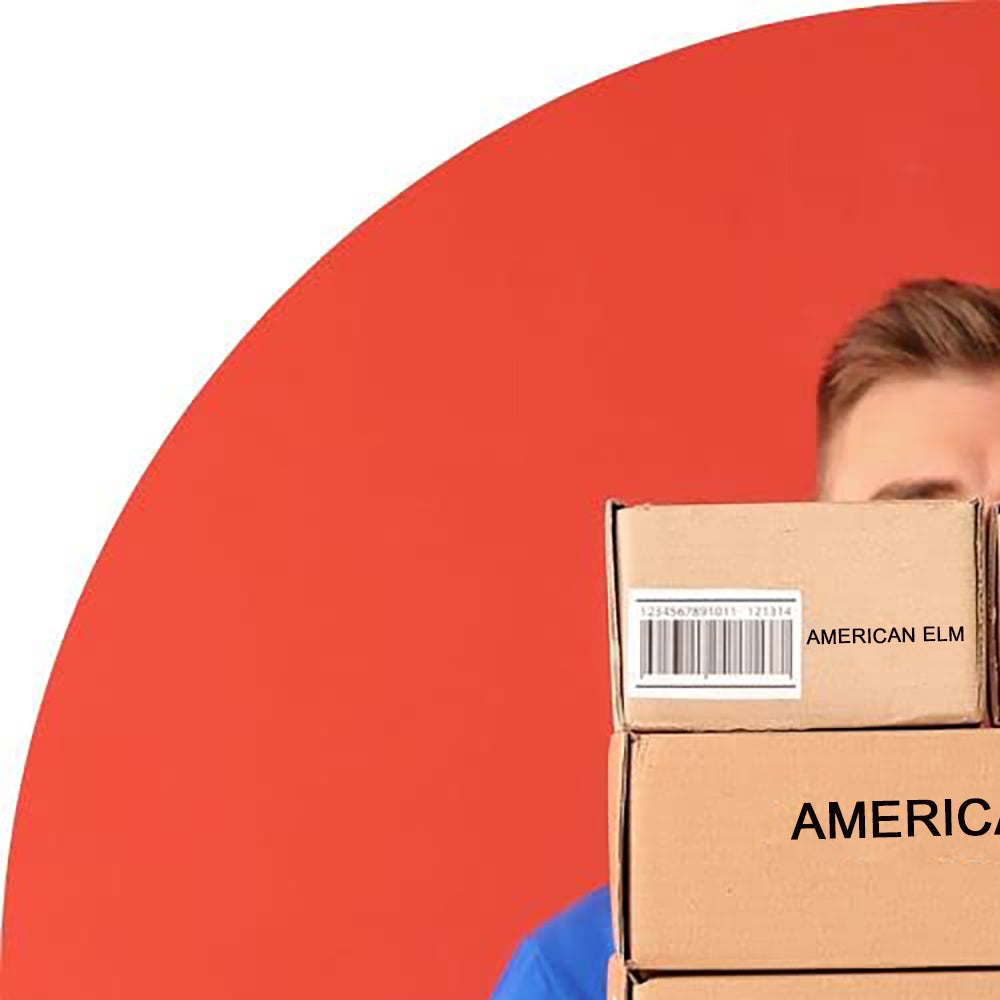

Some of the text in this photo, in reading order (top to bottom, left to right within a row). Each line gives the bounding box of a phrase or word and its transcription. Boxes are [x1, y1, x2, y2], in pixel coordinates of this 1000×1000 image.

[640, 606, 792, 617] 1234567891011 121314
[806, 625, 965, 645] AMERICAN ELM
